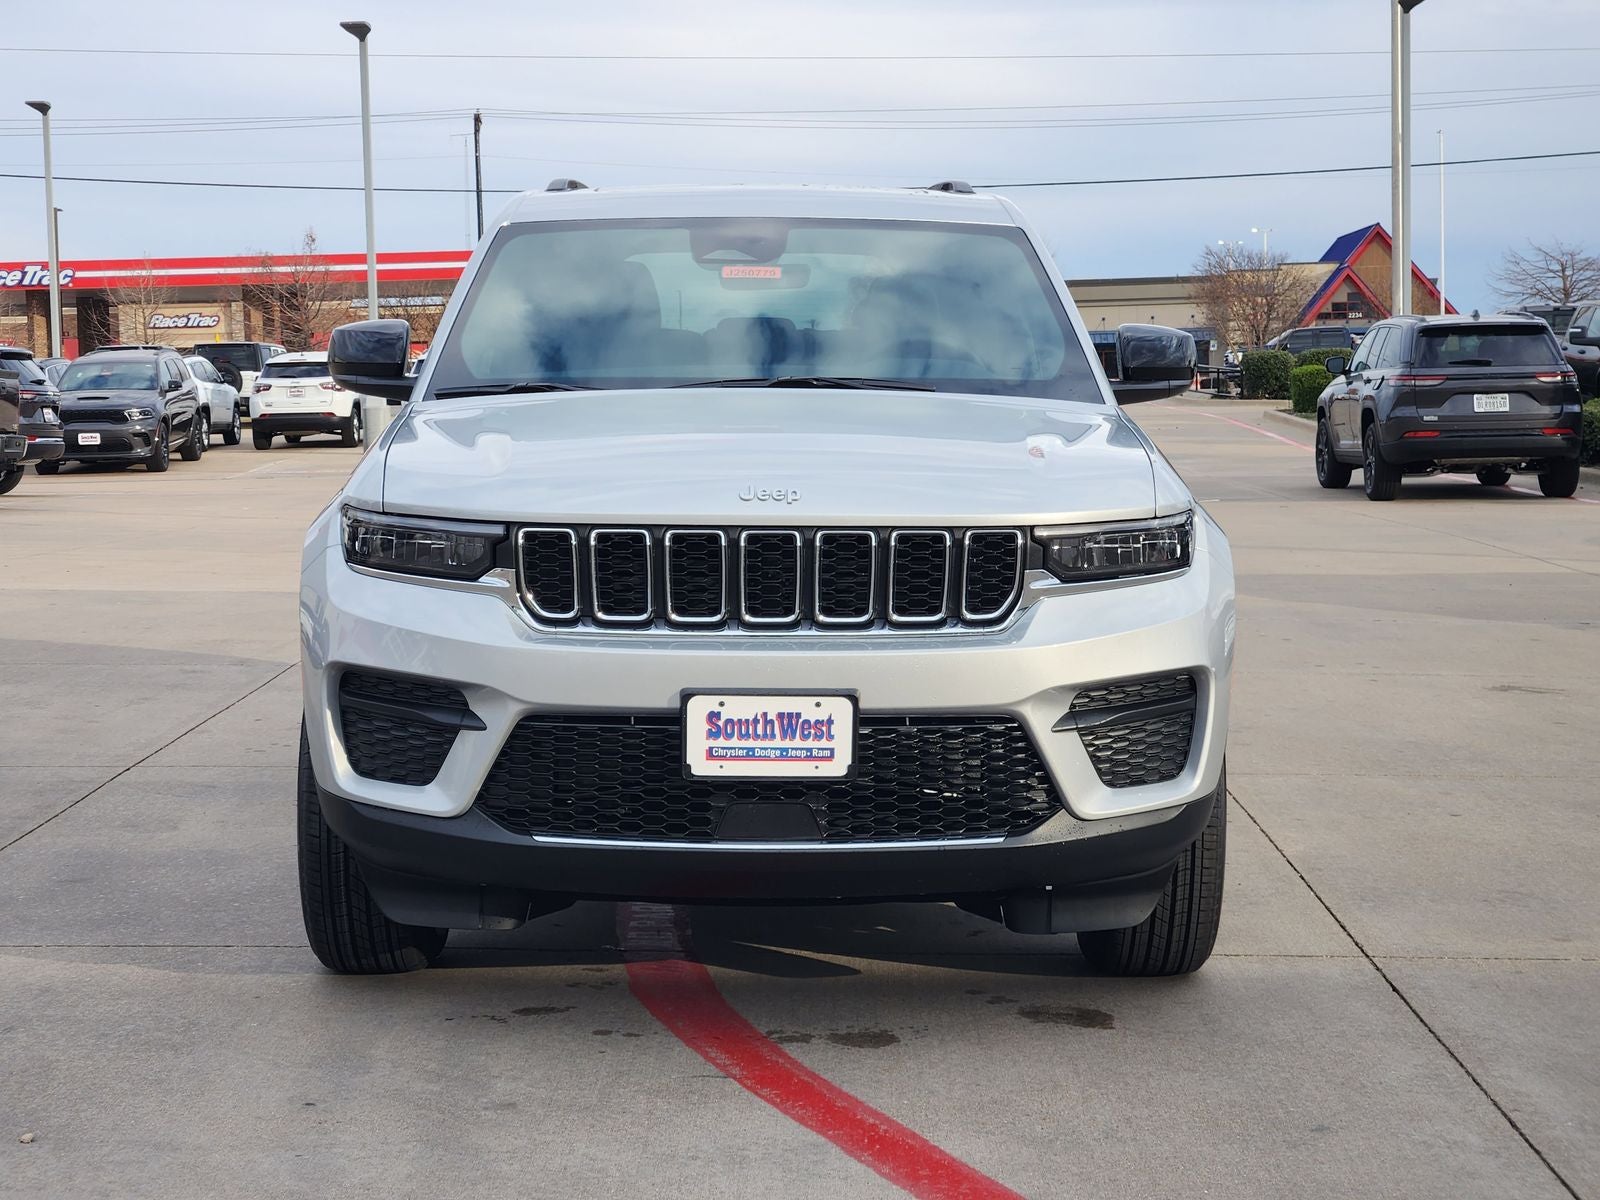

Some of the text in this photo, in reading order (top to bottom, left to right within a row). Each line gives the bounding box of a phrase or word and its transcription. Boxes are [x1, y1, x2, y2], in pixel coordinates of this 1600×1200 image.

[148, 313, 220, 328] RaceTrac
[739, 486, 801, 504] Jeep
[706, 710, 835, 742] SouthWest
[712, 748, 831, 758] Chrysler Dodge Jeep Ram
